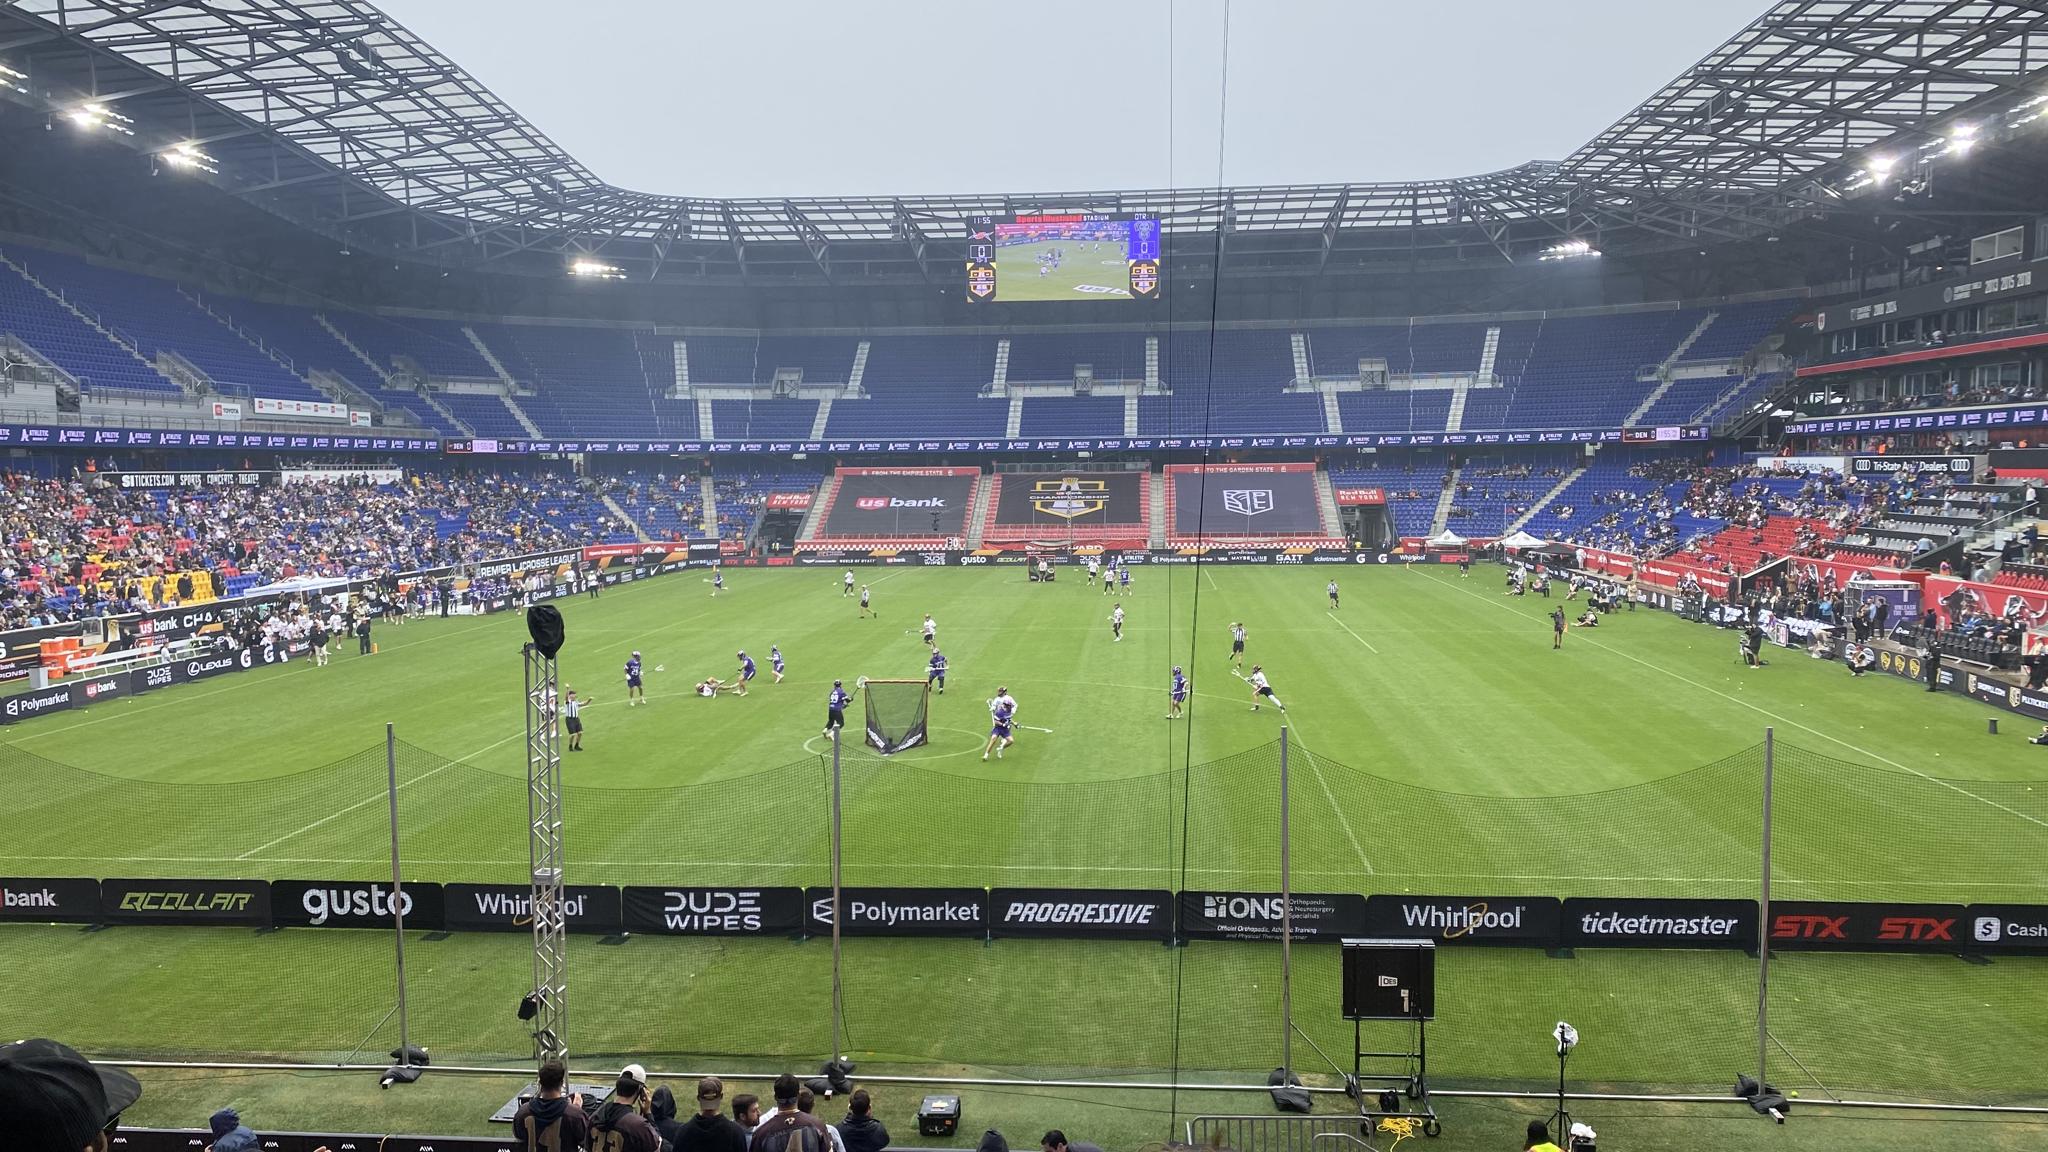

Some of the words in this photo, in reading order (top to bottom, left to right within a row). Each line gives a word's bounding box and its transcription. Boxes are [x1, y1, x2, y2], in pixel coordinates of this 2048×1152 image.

[1873, 460, 1901, 471] Tri-State
[1919, 460, 1948, 471] Dealers
[179, 474, 201, 485] SPORTS
[206, 474, 233, 485] CONCERTS
[889, 498, 945, 507] bank
[512, 558, 550, 573] LACROSSE
[550, 553, 576, 566] LEAGUE
[960, 556, 986, 566] gusto
[1356, 554, 1366, 563] G
[1378, 554, 1387, 563] G
[153, 616, 178, 632] bank
[240, 648, 251, 667] G
[264, 644, 275, 663] G
[200, 657, 232, 671] LEXUS
[147, 667, 172, 680] DUDE
[147, 674, 172, 686] WIPES
[87, 685, 97, 694] us
[97, 680, 117, 693] bank
[21, 692, 69, 712] Polymarket
[5, 888, 57, 907] bank
[664, 891, 761, 913] DUDE
[302, 888, 413, 926] gusto
[851, 901, 980, 926] Polymarket
[1004, 902, 1155, 925] PROGRESSIVE
[665, 914, 761, 931] WIPES
[1402, 903, 1522, 934] Whirlpool
[1581, 912, 1737, 937] ticketmaster
[1772, 915, 1853, 940] STX
[1877, 917, 1956, 941] STX
[2006, 922, 2048, 939] Cash
